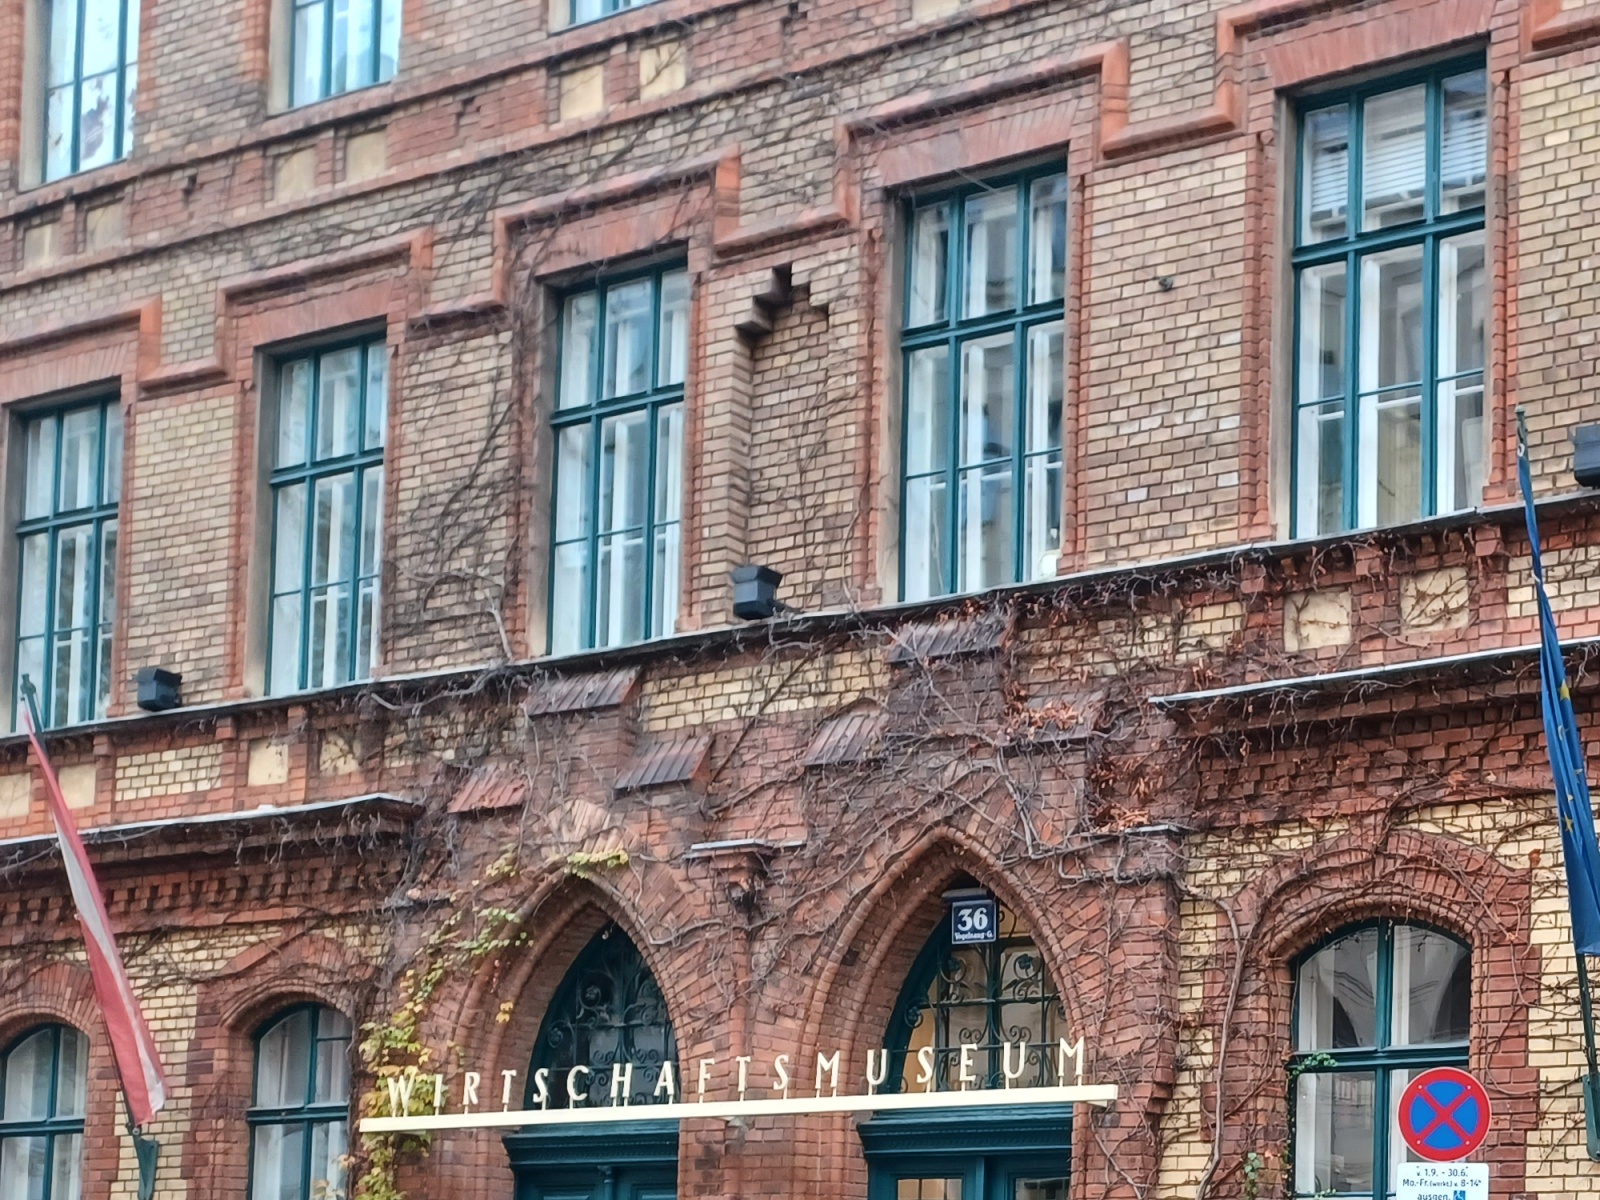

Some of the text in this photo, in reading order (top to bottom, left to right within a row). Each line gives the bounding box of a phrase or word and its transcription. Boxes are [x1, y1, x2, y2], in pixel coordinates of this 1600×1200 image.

[957, 907, 988, 931] 36
[387, 1036, 1085, 1107] WIRTSCHAFTSMUSEUM
[1424, 1168, 1439, 1177] 1.9.
[1447, 1168, 1469, 1177] 30.6.
